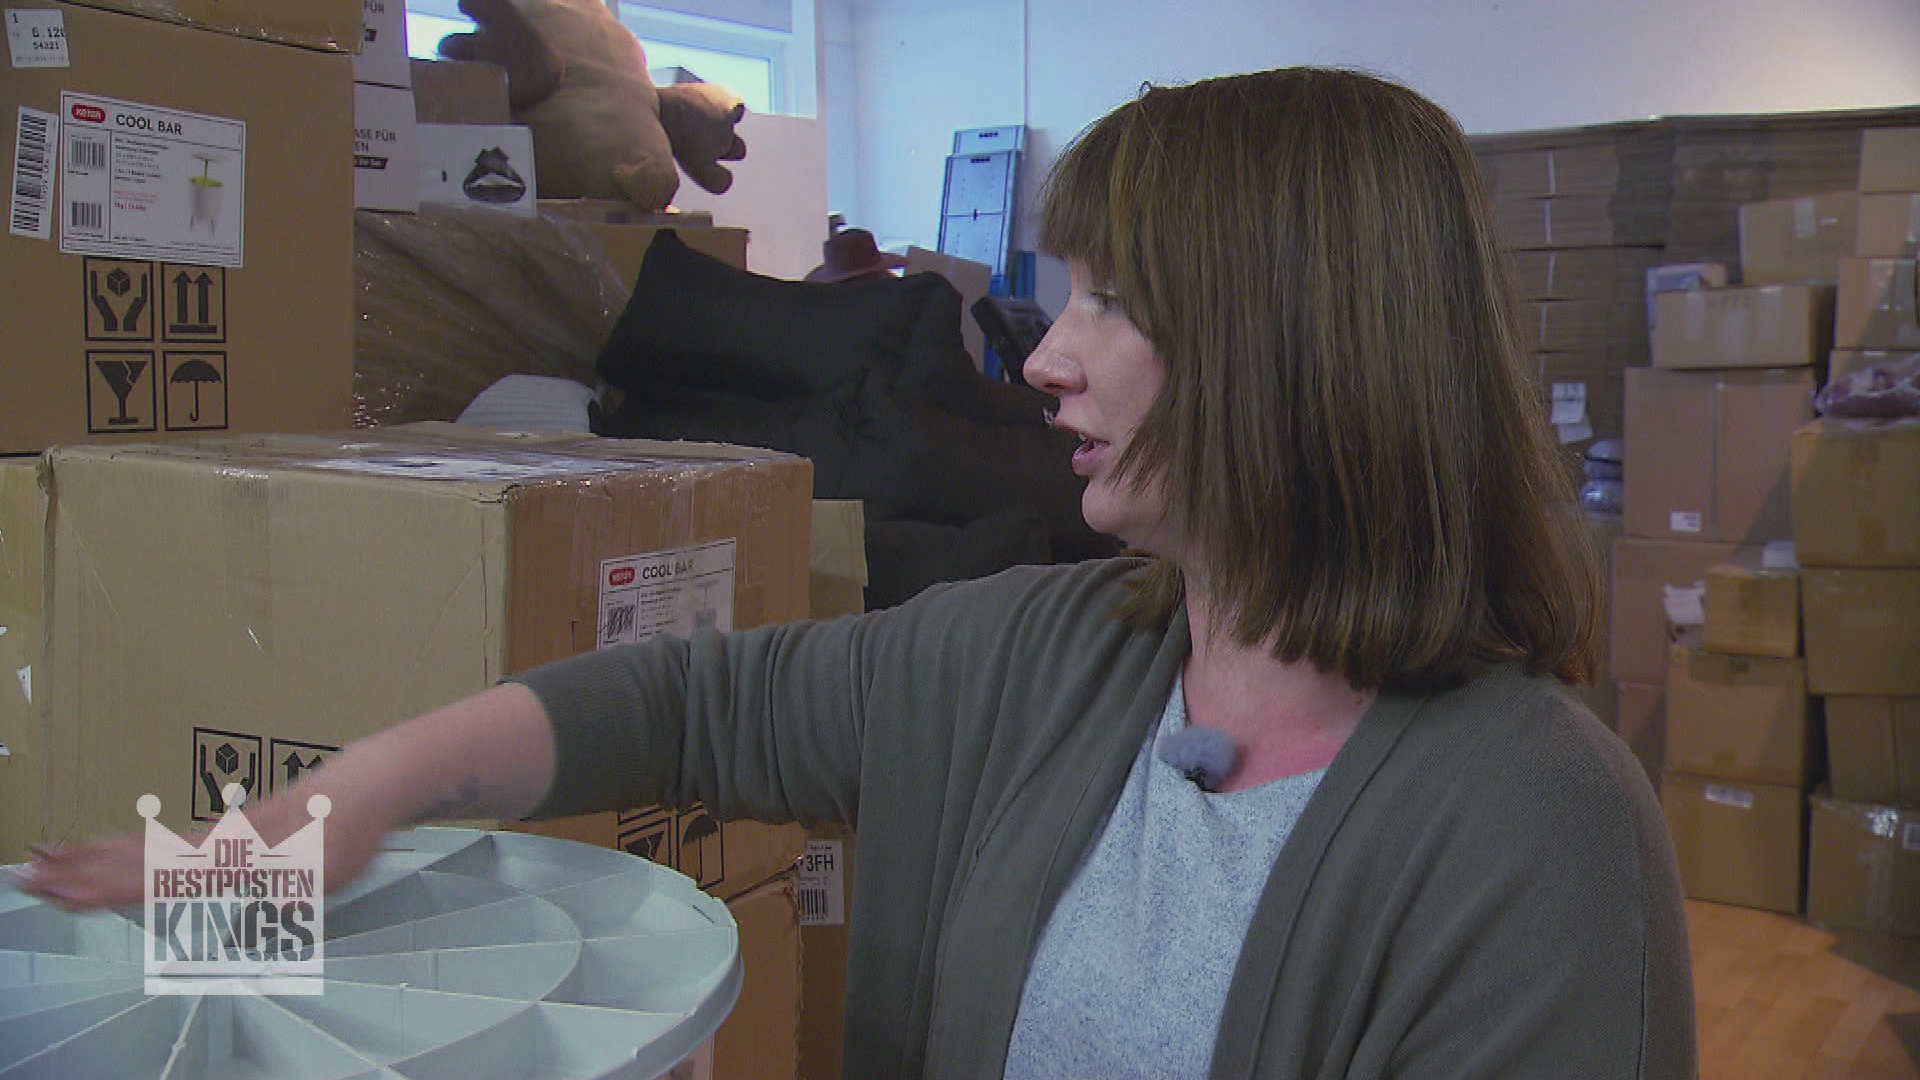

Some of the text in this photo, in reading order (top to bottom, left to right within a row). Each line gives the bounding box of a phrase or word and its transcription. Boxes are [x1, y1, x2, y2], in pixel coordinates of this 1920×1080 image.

[115, 114, 154, 131] COOL
[158, 120, 182, 136] BAR
[375, 128, 396, 142] FÜR
[642, 564, 673, 580] COOL
[675, 559, 693, 575] BAR
